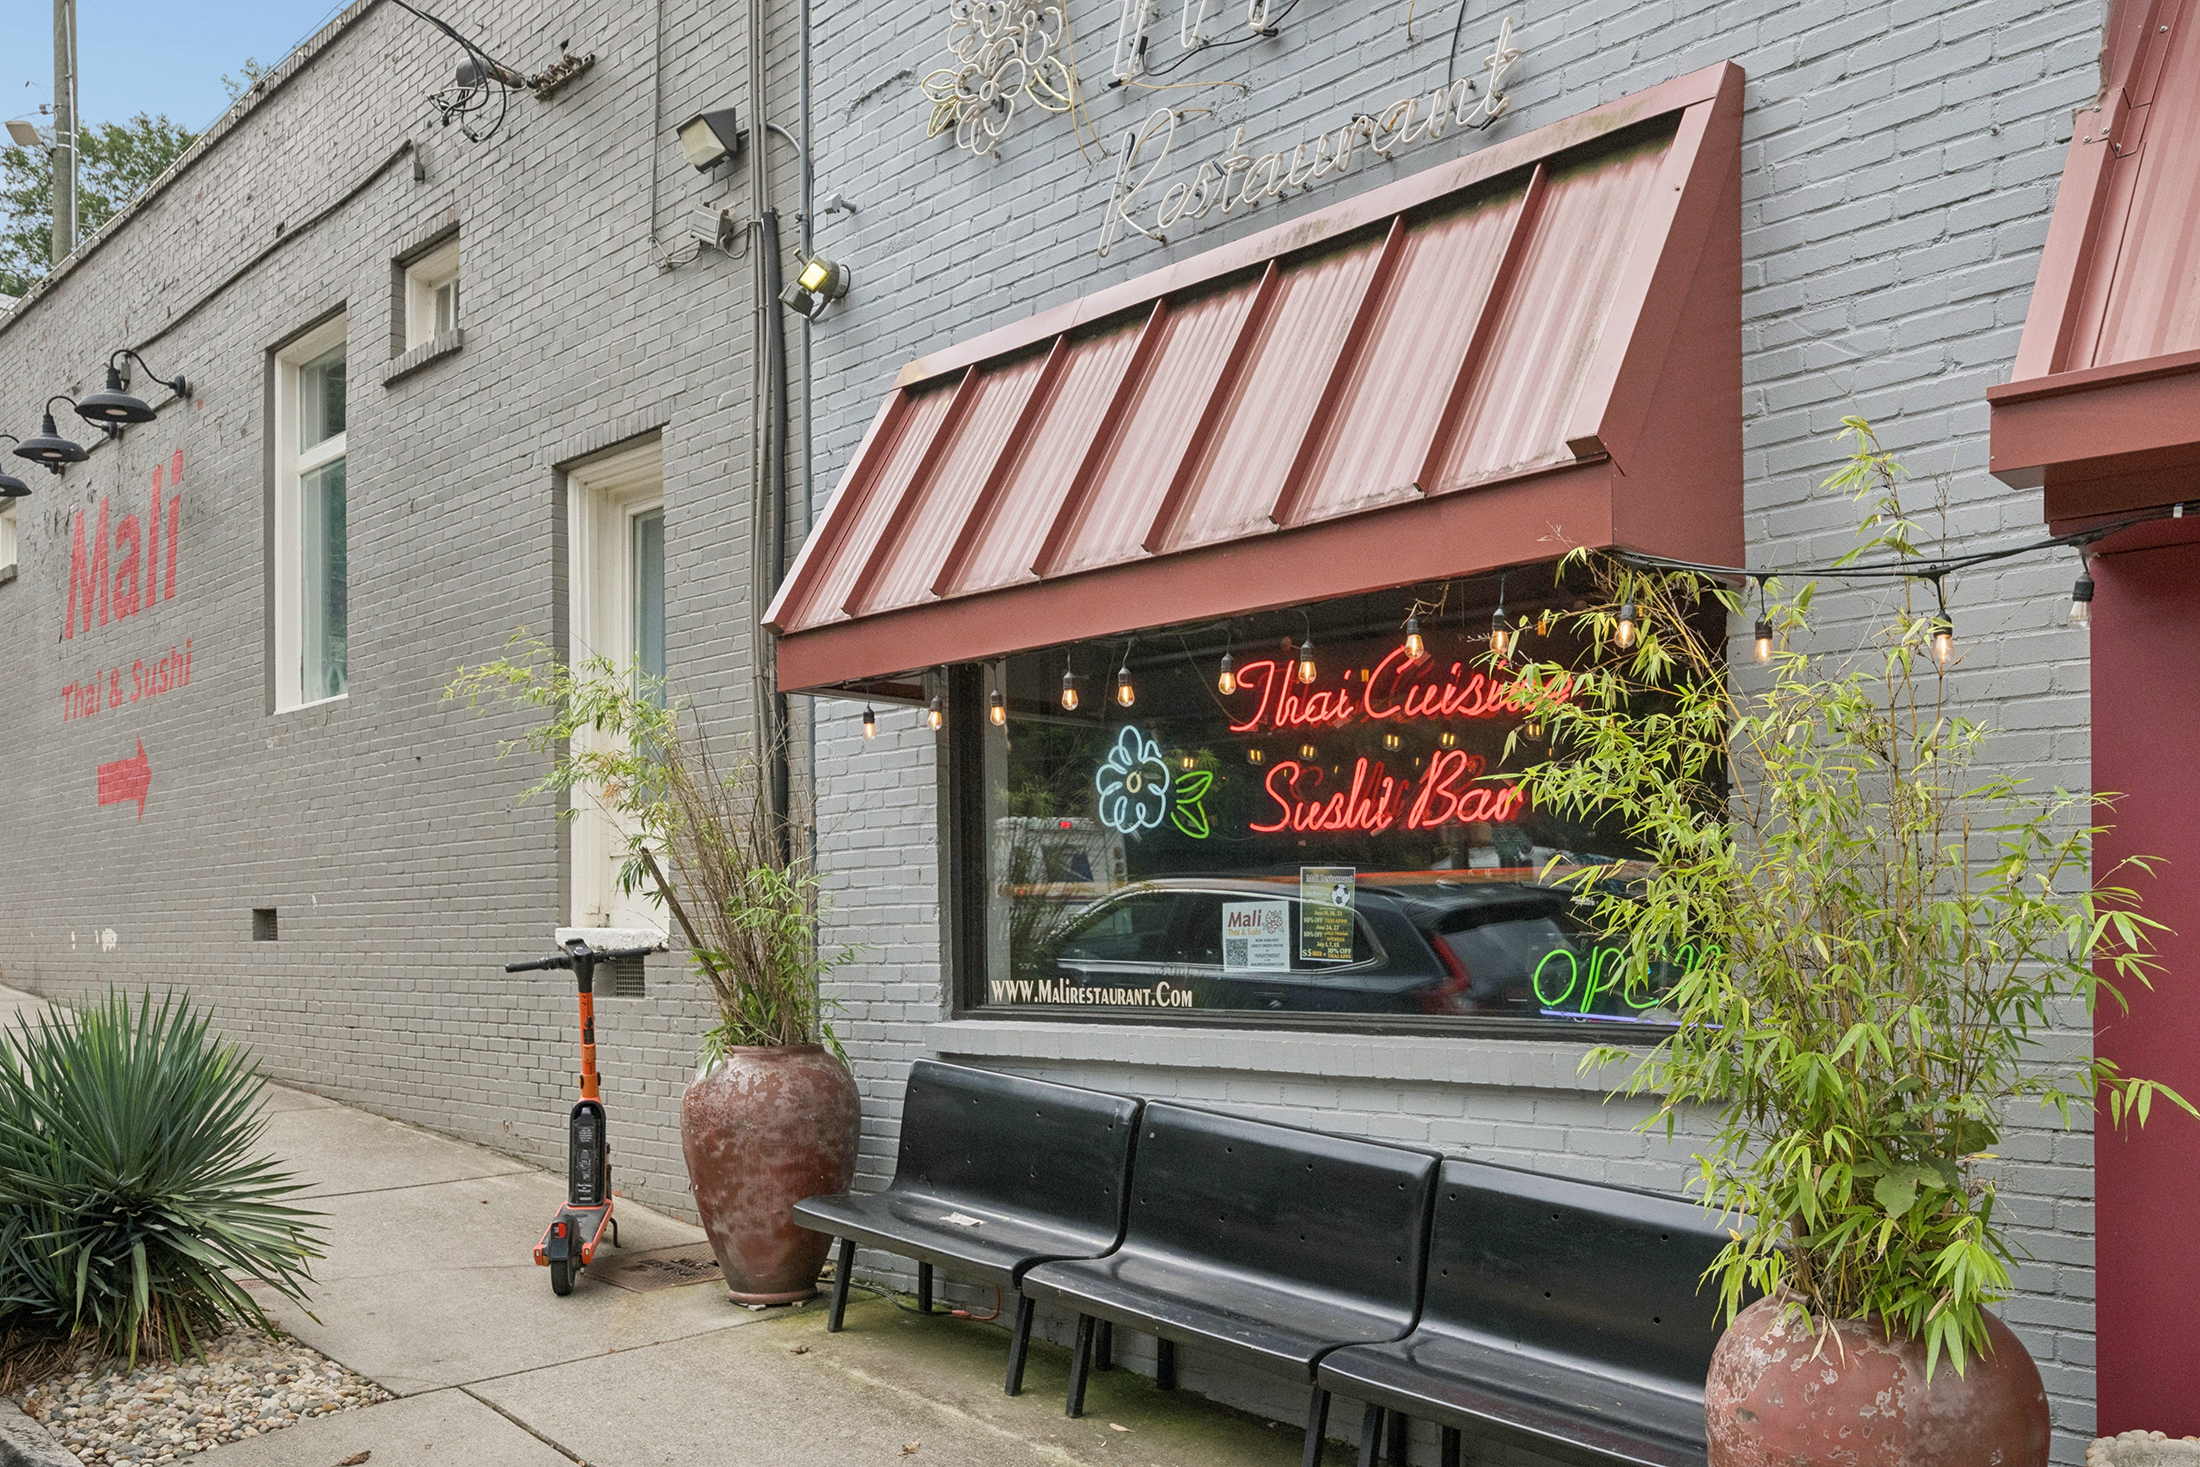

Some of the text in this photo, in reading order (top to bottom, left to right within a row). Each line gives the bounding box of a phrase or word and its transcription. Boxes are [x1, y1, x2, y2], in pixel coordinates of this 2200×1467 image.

[1098, 16, 1521, 258] Restaurant
[65, 448, 184, 640] Mali
[62, 637, 192, 724] Thai & Sushi
[1230, 659, 1354, 732] Thai
[1250, 749, 1523, 832] Sushi Bar
[1228, 909, 1262, 928] Mali
[1248, 928, 1262, 936] Sushi
